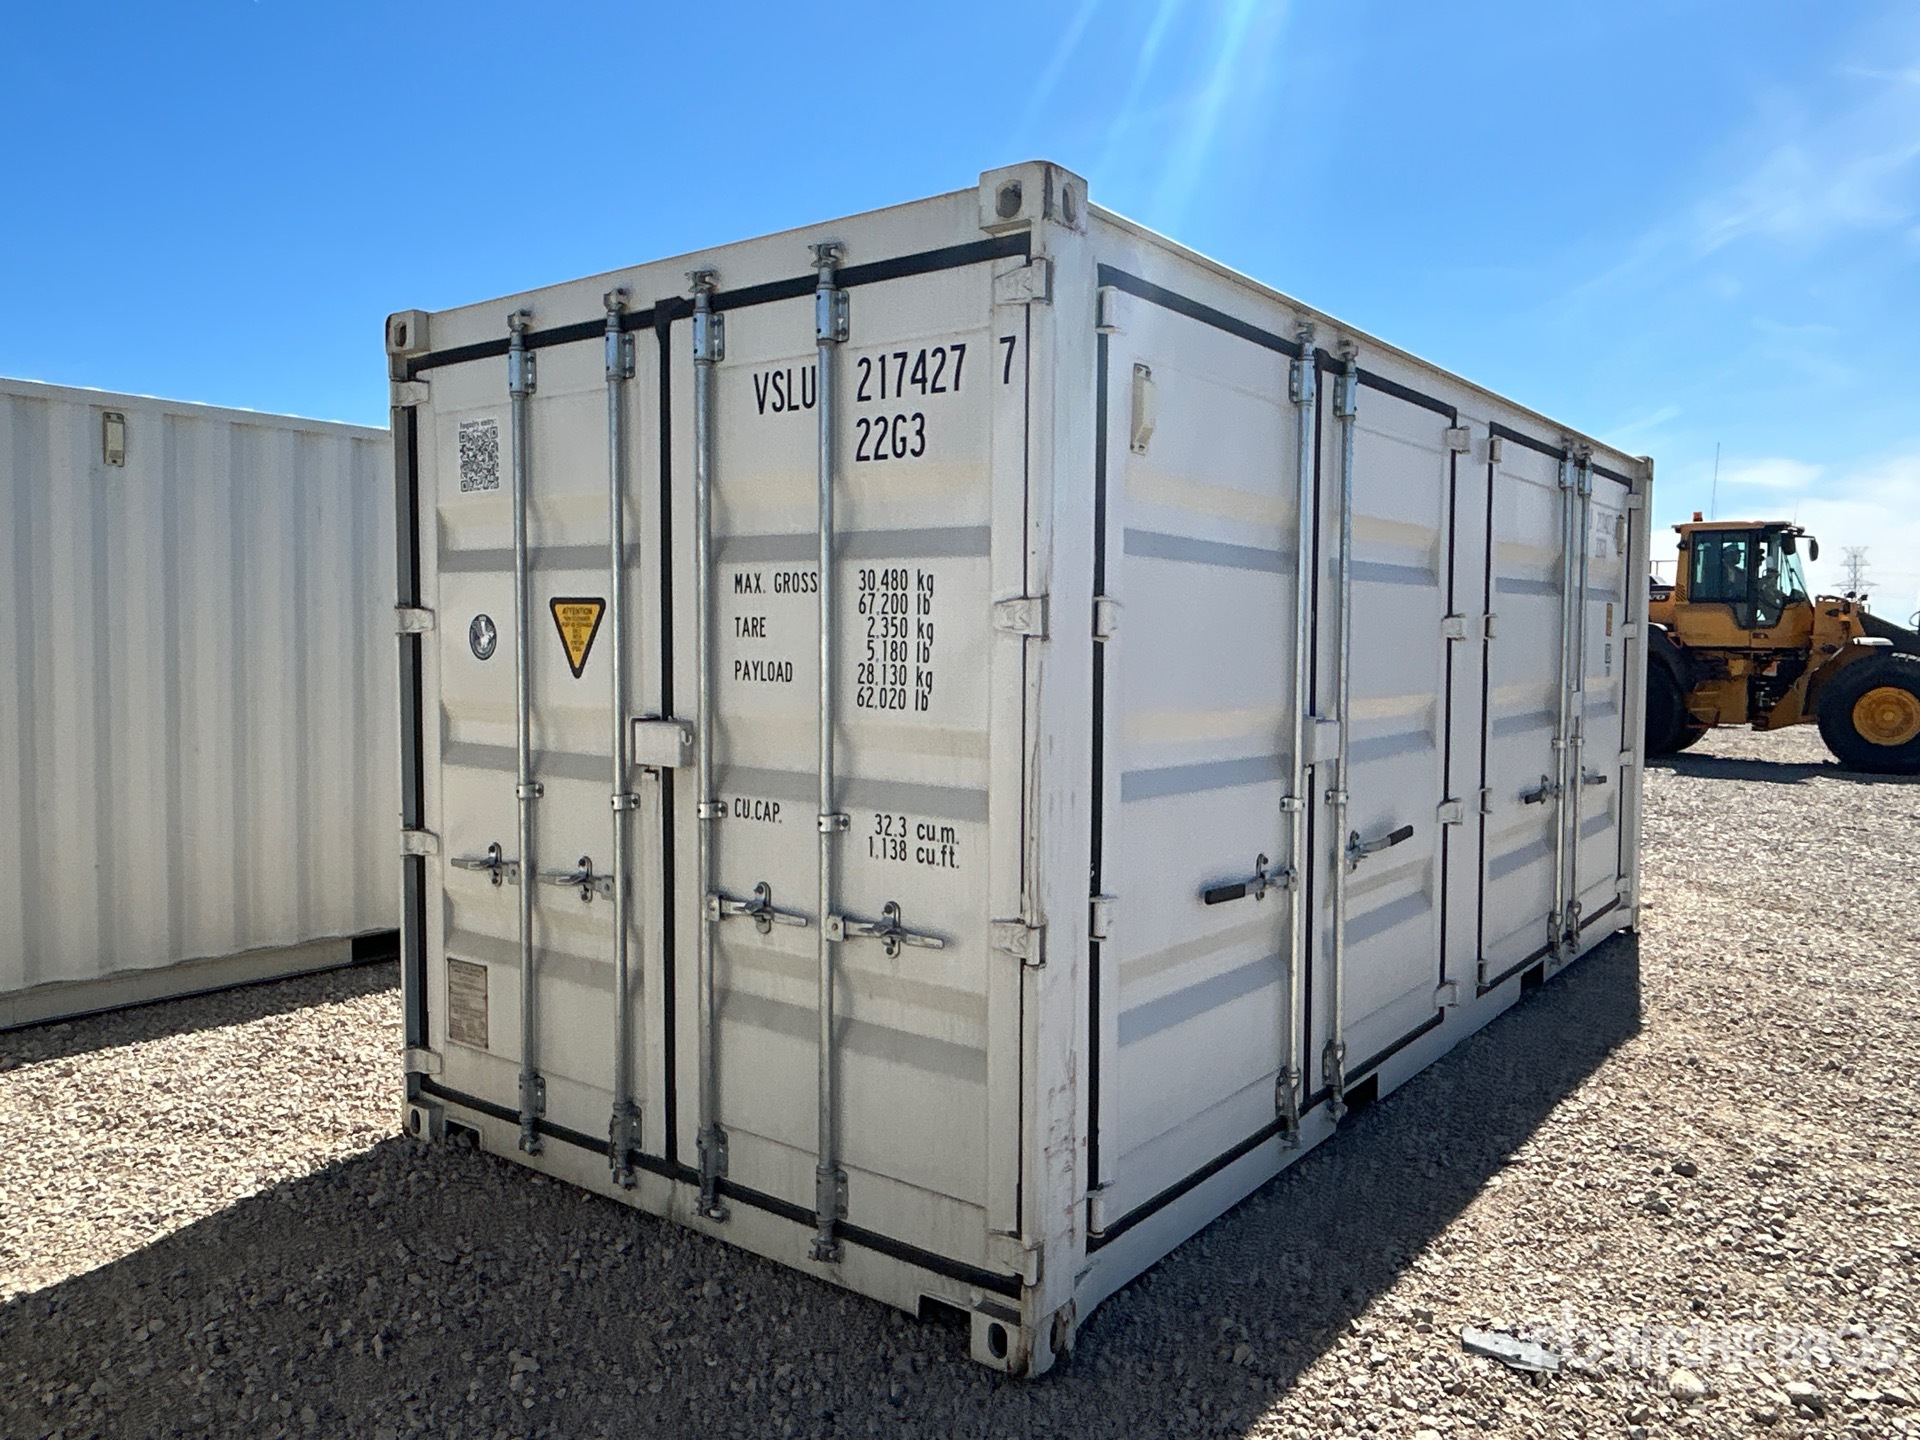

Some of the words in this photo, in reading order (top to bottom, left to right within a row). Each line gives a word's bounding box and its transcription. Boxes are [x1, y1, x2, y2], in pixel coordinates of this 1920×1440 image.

[753, 365, 816, 415] VSLU
[856, 344, 966, 402] 217427
[1000, 335, 1016, 384] 7
[856, 412, 926, 462] 22G3
[735, 573, 766, 594] MAX.
[774, 572, 818, 593] GROSS
[917, 569, 934, 598] kg
[917, 593, 930, 615] lb
[735, 617, 766, 637] TARE
[917, 617, 934, 646] kg
[916, 641, 929, 663] lb
[735, 660, 793, 682] PAYLOAD
[916, 666, 933, 694] kg
[915, 689, 928, 711] lb
[735, 798, 782, 823] CU.CAP.
[875, 814, 906, 837] 32.3
[917, 823, 959, 845] cu.m.
[916, 846, 959, 868] cu.ft.
